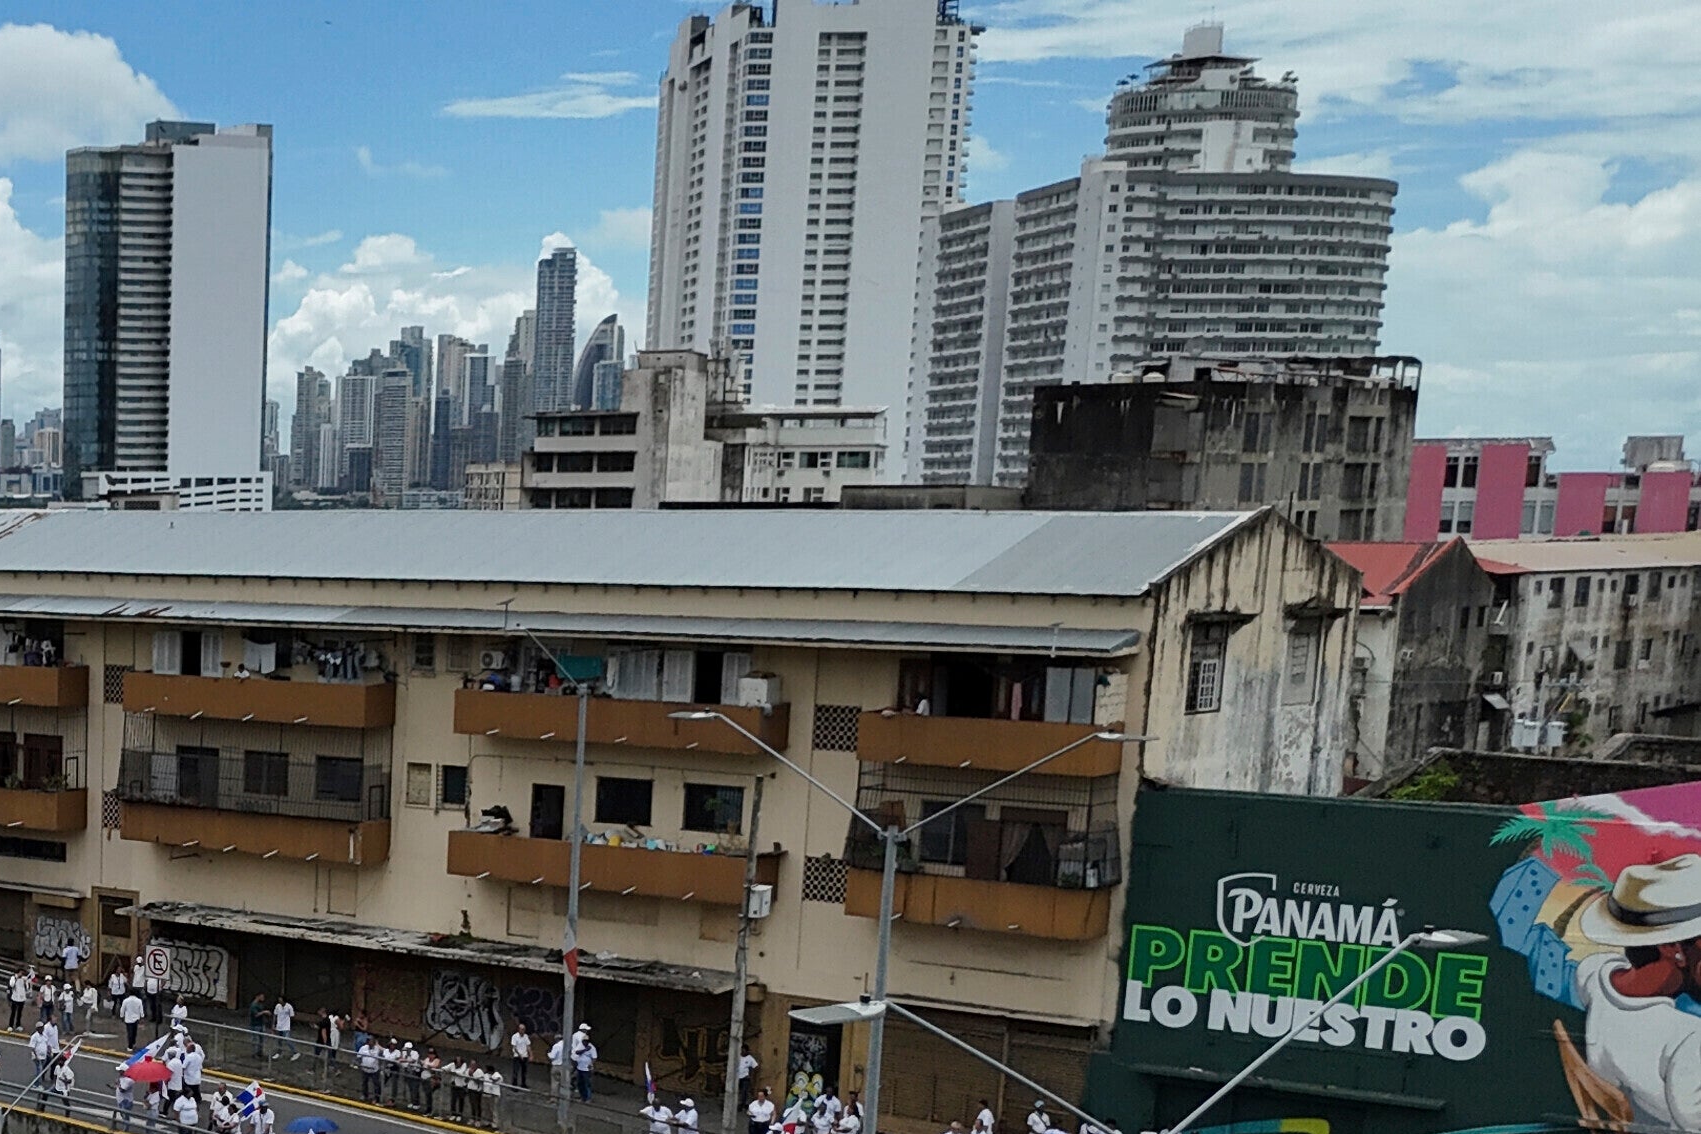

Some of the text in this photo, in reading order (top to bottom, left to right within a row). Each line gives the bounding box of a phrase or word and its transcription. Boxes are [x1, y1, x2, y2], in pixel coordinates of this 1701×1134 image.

[1227, 887, 1400, 947] PANAMÁ
[1293, 881, 1340, 897] CERVEZA
[1127, 924, 1489, 1022] PRENDE
[1123, 979, 1487, 1061] LO NUESTRO
